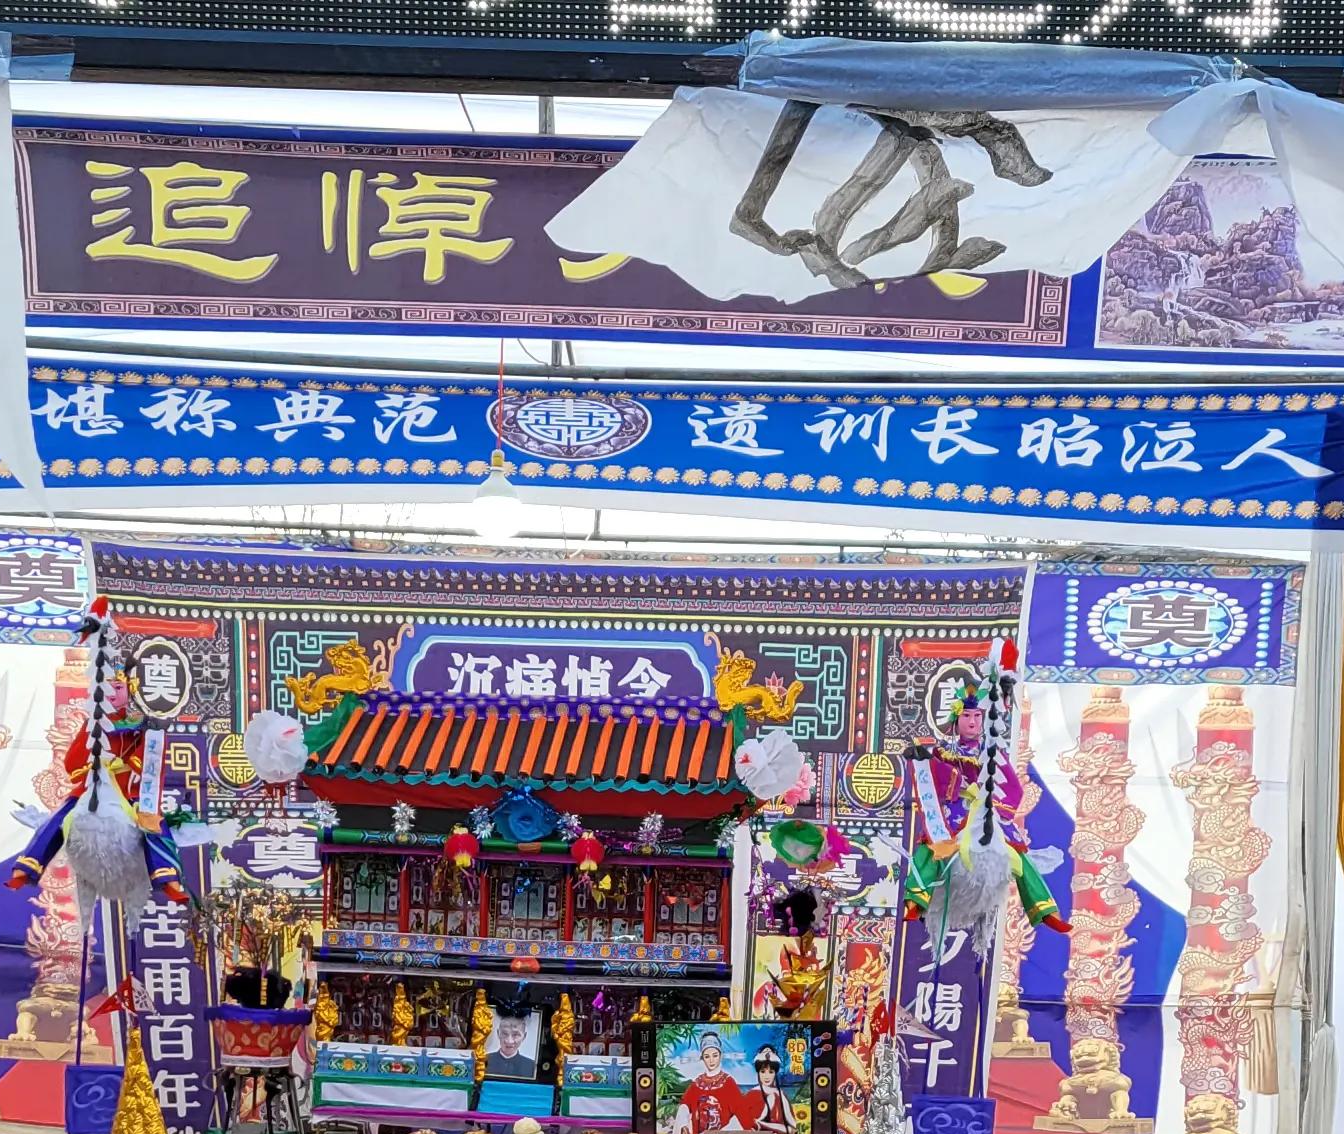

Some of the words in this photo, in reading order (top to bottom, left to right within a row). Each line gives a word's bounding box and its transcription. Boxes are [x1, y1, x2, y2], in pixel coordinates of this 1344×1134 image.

[1119, 594, 1218, 648] 奠
[141, 654, 181, 704] 奠
[247, 832, 322, 872] 奠
